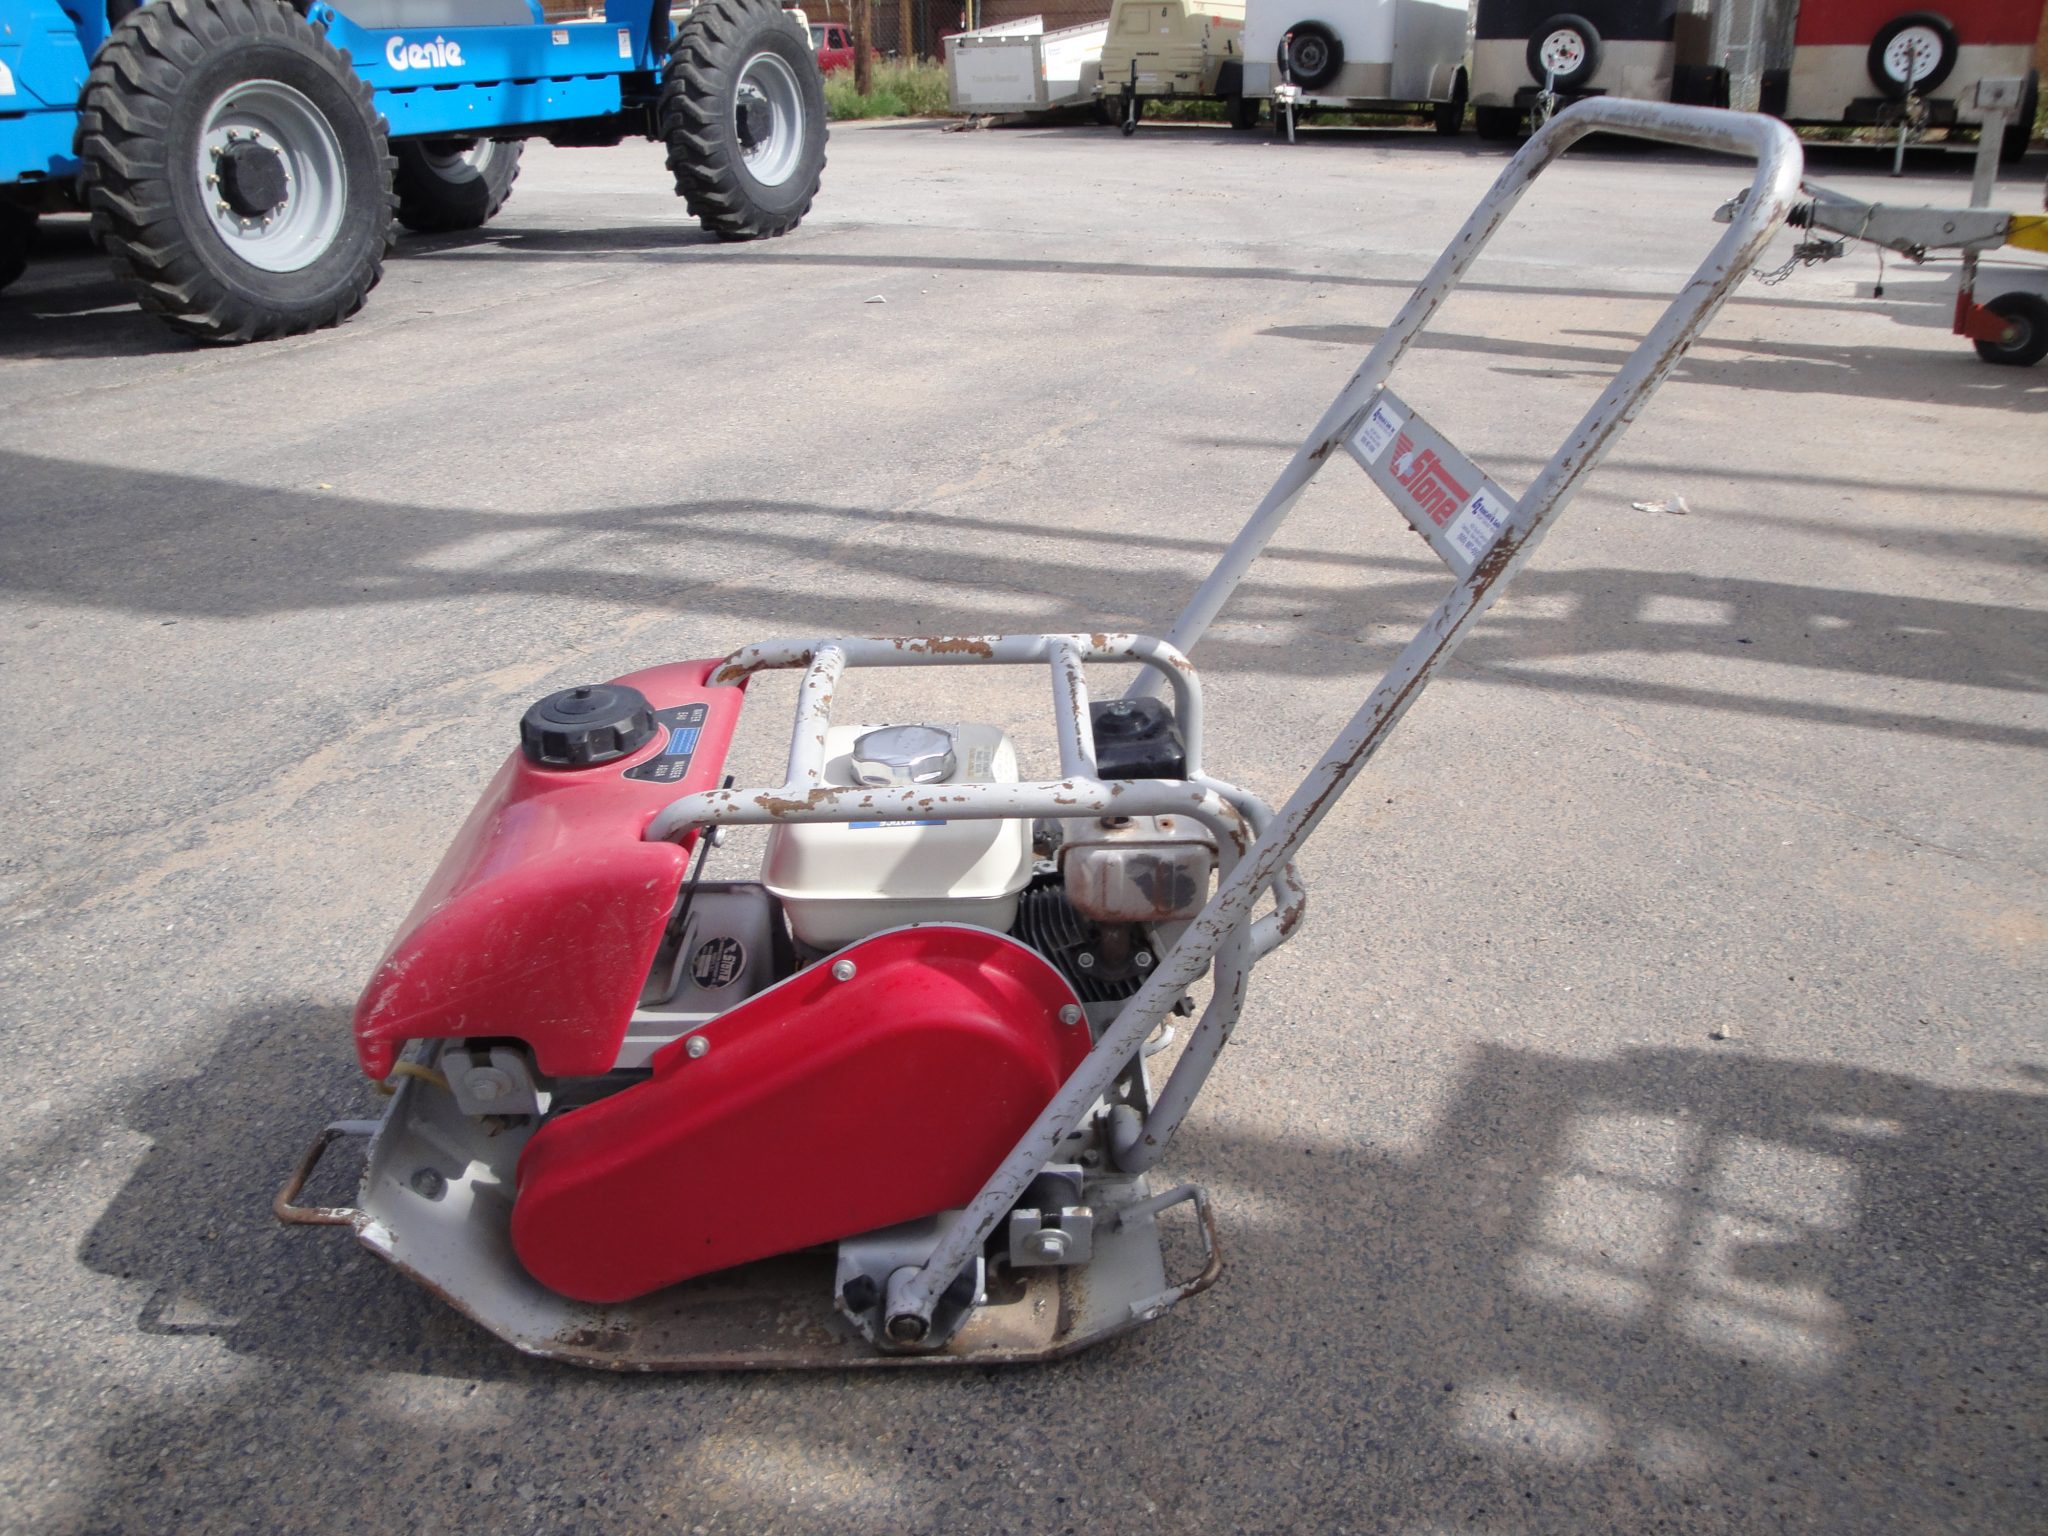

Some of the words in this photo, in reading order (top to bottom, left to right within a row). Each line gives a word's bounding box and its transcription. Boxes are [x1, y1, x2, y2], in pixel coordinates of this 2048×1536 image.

[386, 35, 464, 71] Genie
[1397, 448, 1471, 527] Stone
[691, 708, 704, 723] WATER
